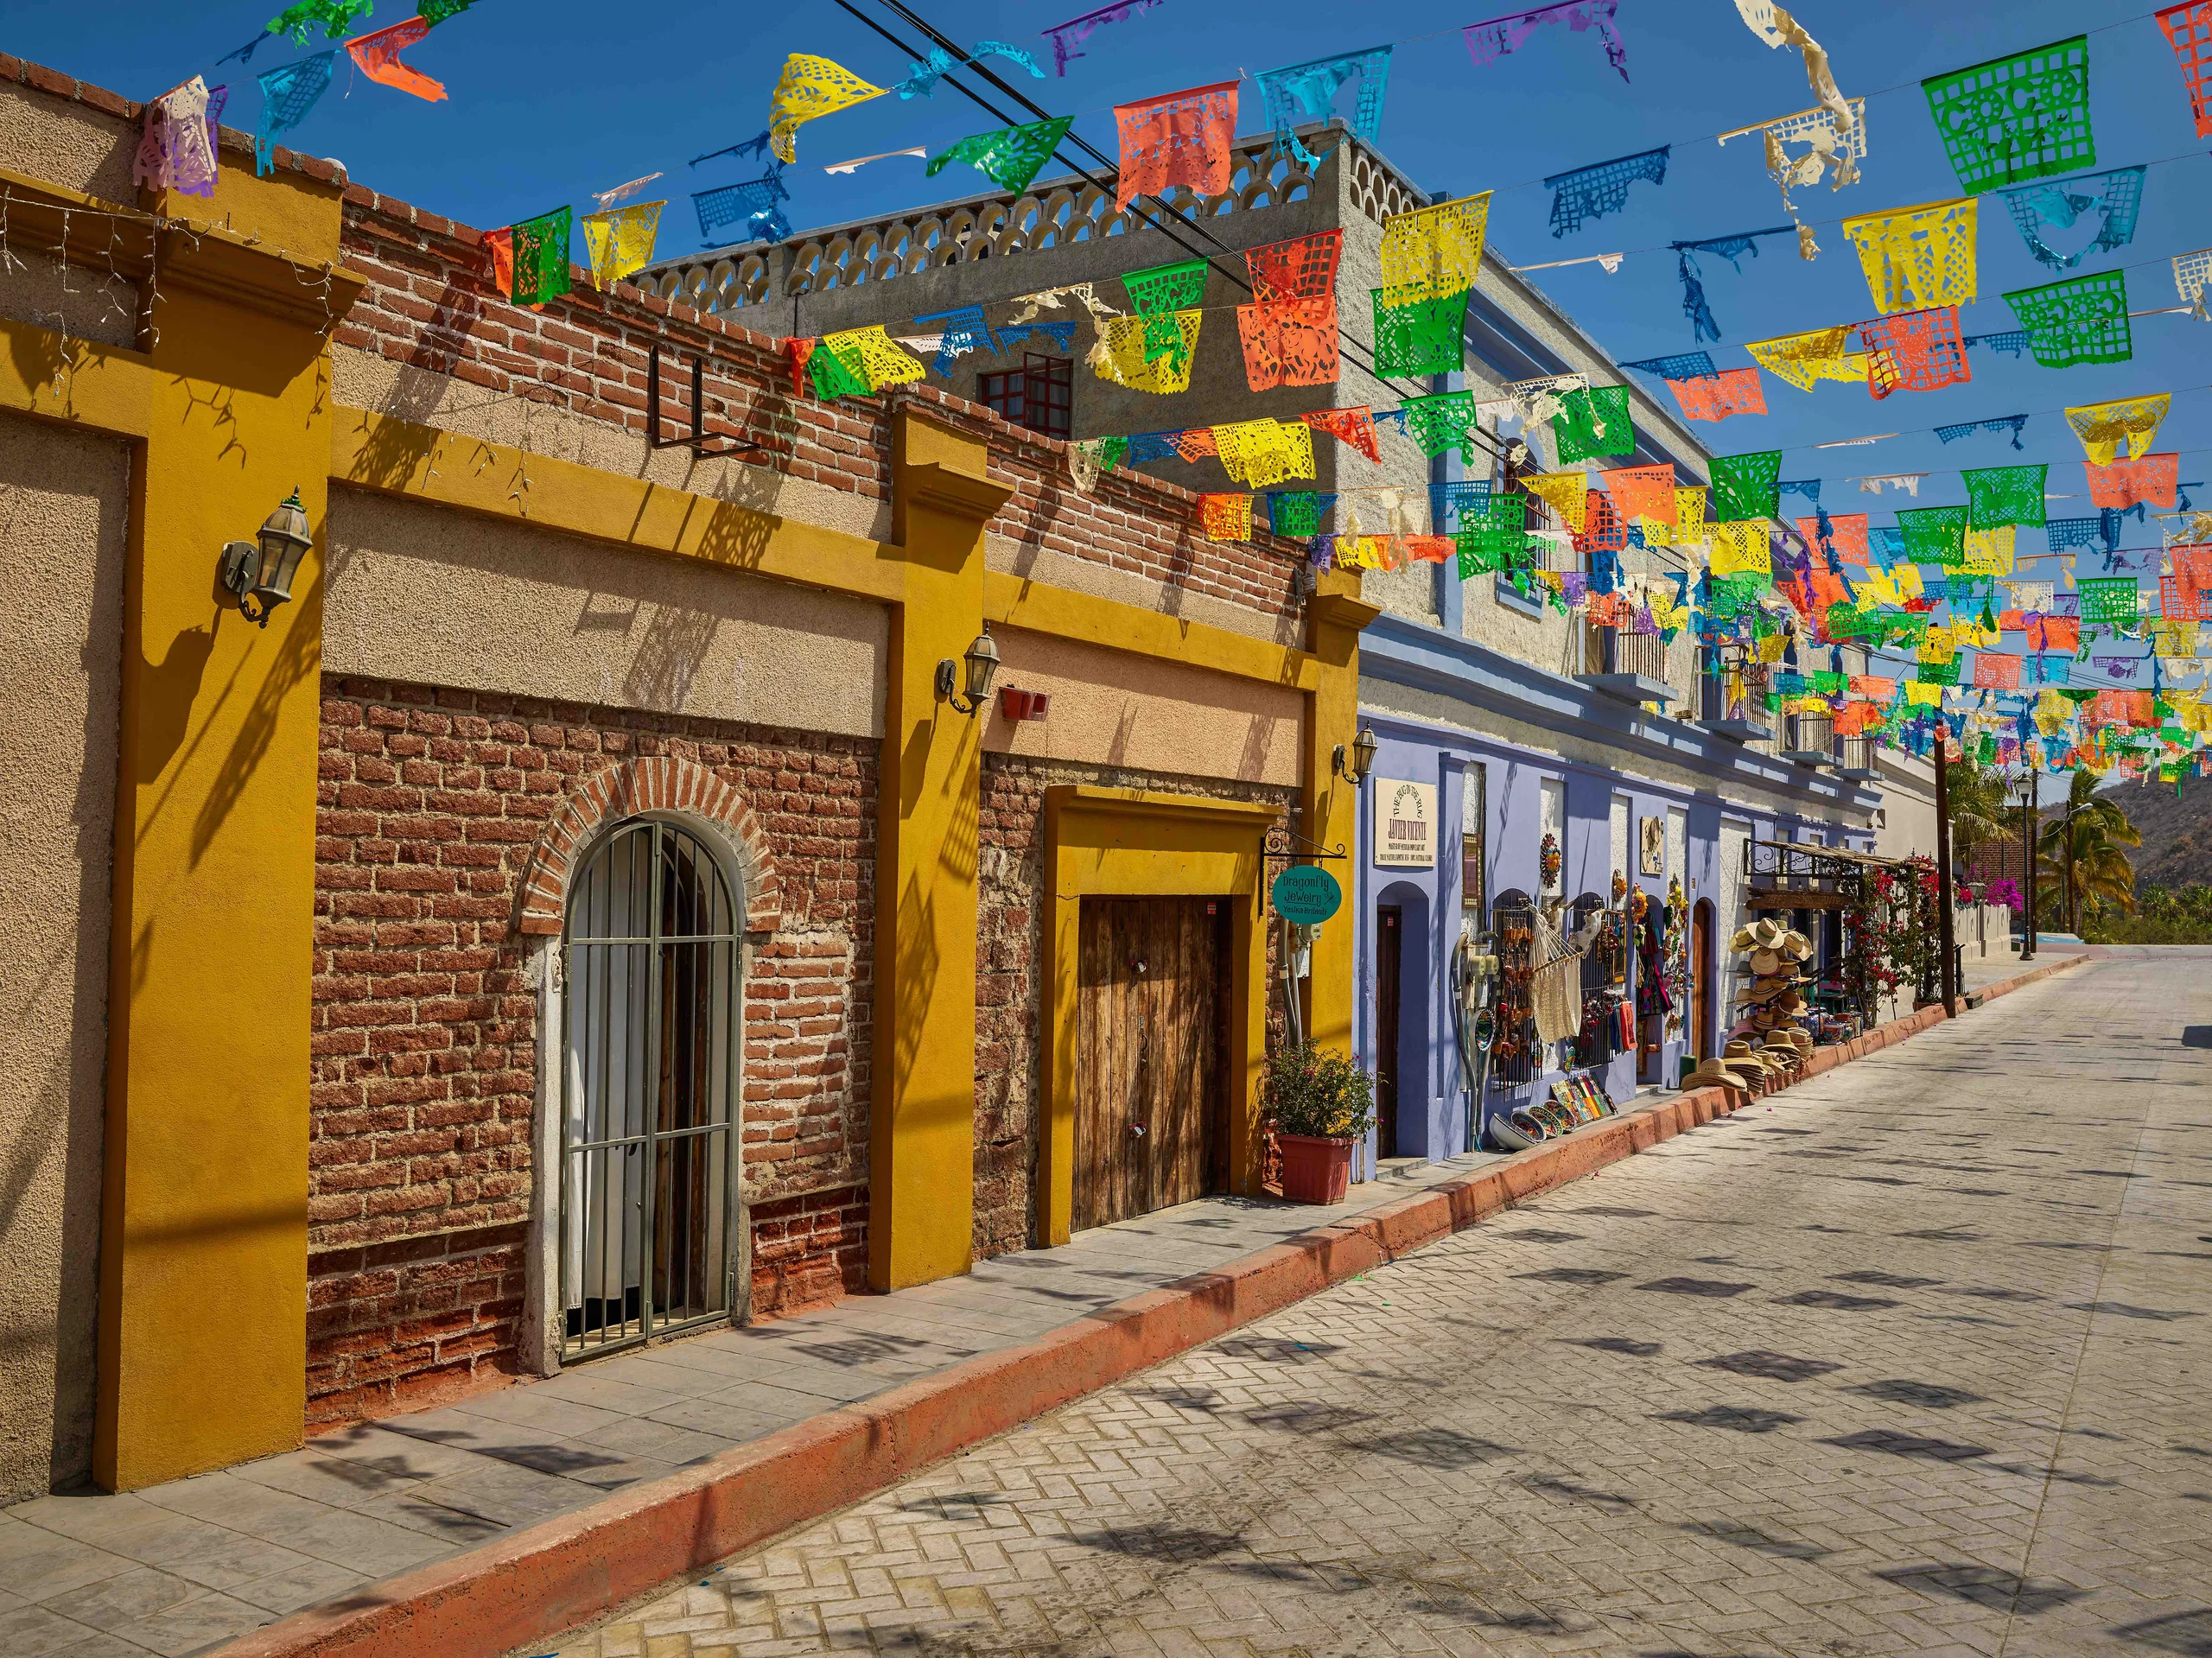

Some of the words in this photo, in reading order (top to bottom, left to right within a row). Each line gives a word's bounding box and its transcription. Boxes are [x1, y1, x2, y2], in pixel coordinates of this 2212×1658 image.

[1941, 69, 2079, 134] COCO
[1388, 818, 1407, 841] JAVIER
[1407, 821, 1427, 841] VICENTE
[1282, 874, 1330, 892] Dragonfly
[1283, 905, 1303, 914] Yesika
